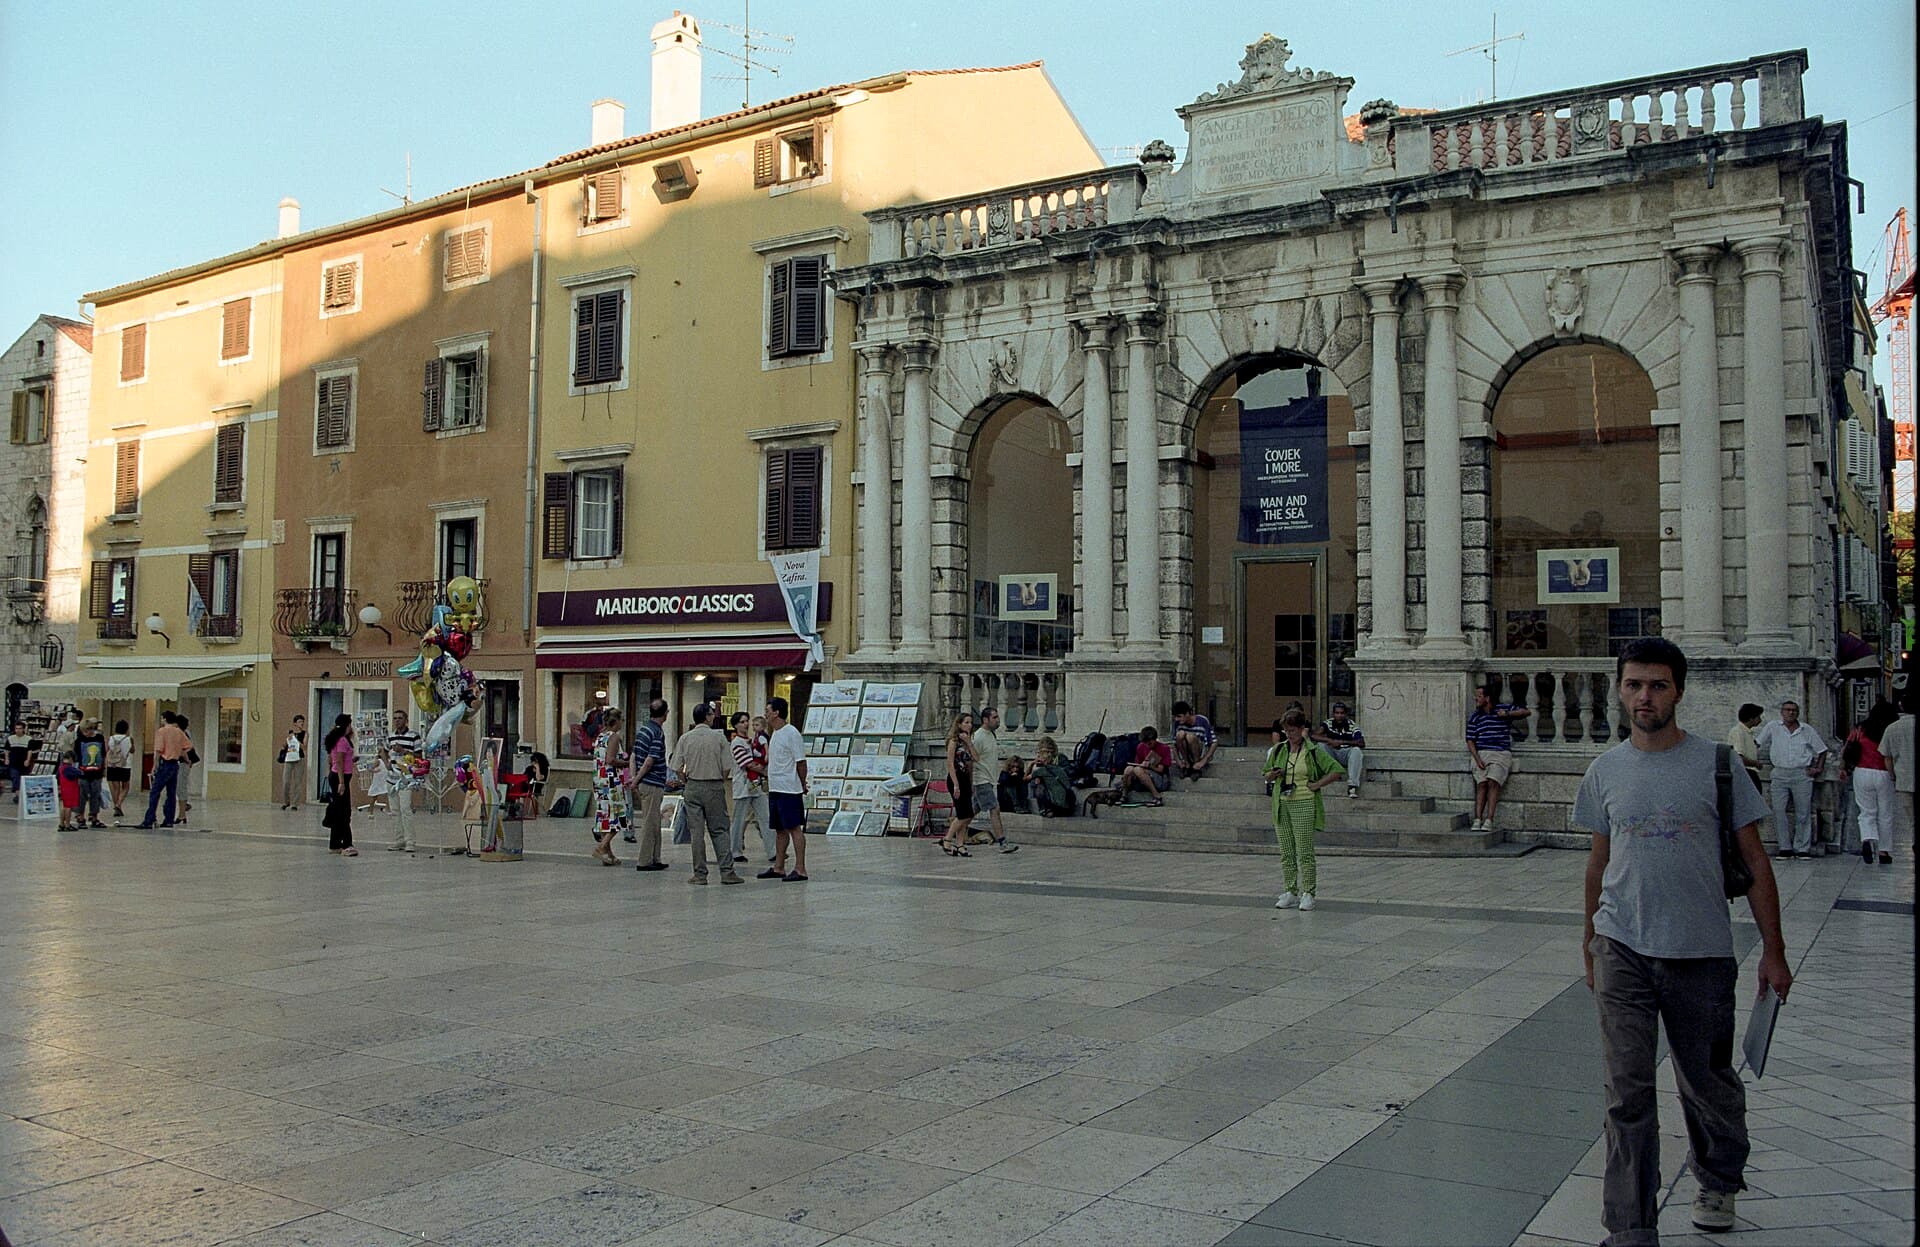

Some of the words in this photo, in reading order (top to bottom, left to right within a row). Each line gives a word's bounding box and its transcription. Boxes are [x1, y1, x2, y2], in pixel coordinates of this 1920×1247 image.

[1265, 447, 1301, 462] ČOVJEK
[1265, 463, 1269, 474] I
[1272, 461, 1301, 473] MORE
[1260, 496, 1283, 509] MAN
[1285, 495, 1307, 507] AND
[1263, 508, 1283, 520] THE
[1285, 507, 1305, 519] SEA
[784, 561, 805, 571] Nova
[682, 593, 754, 613] CLASSICS
[345, 660, 392, 676] SUNTURIST
